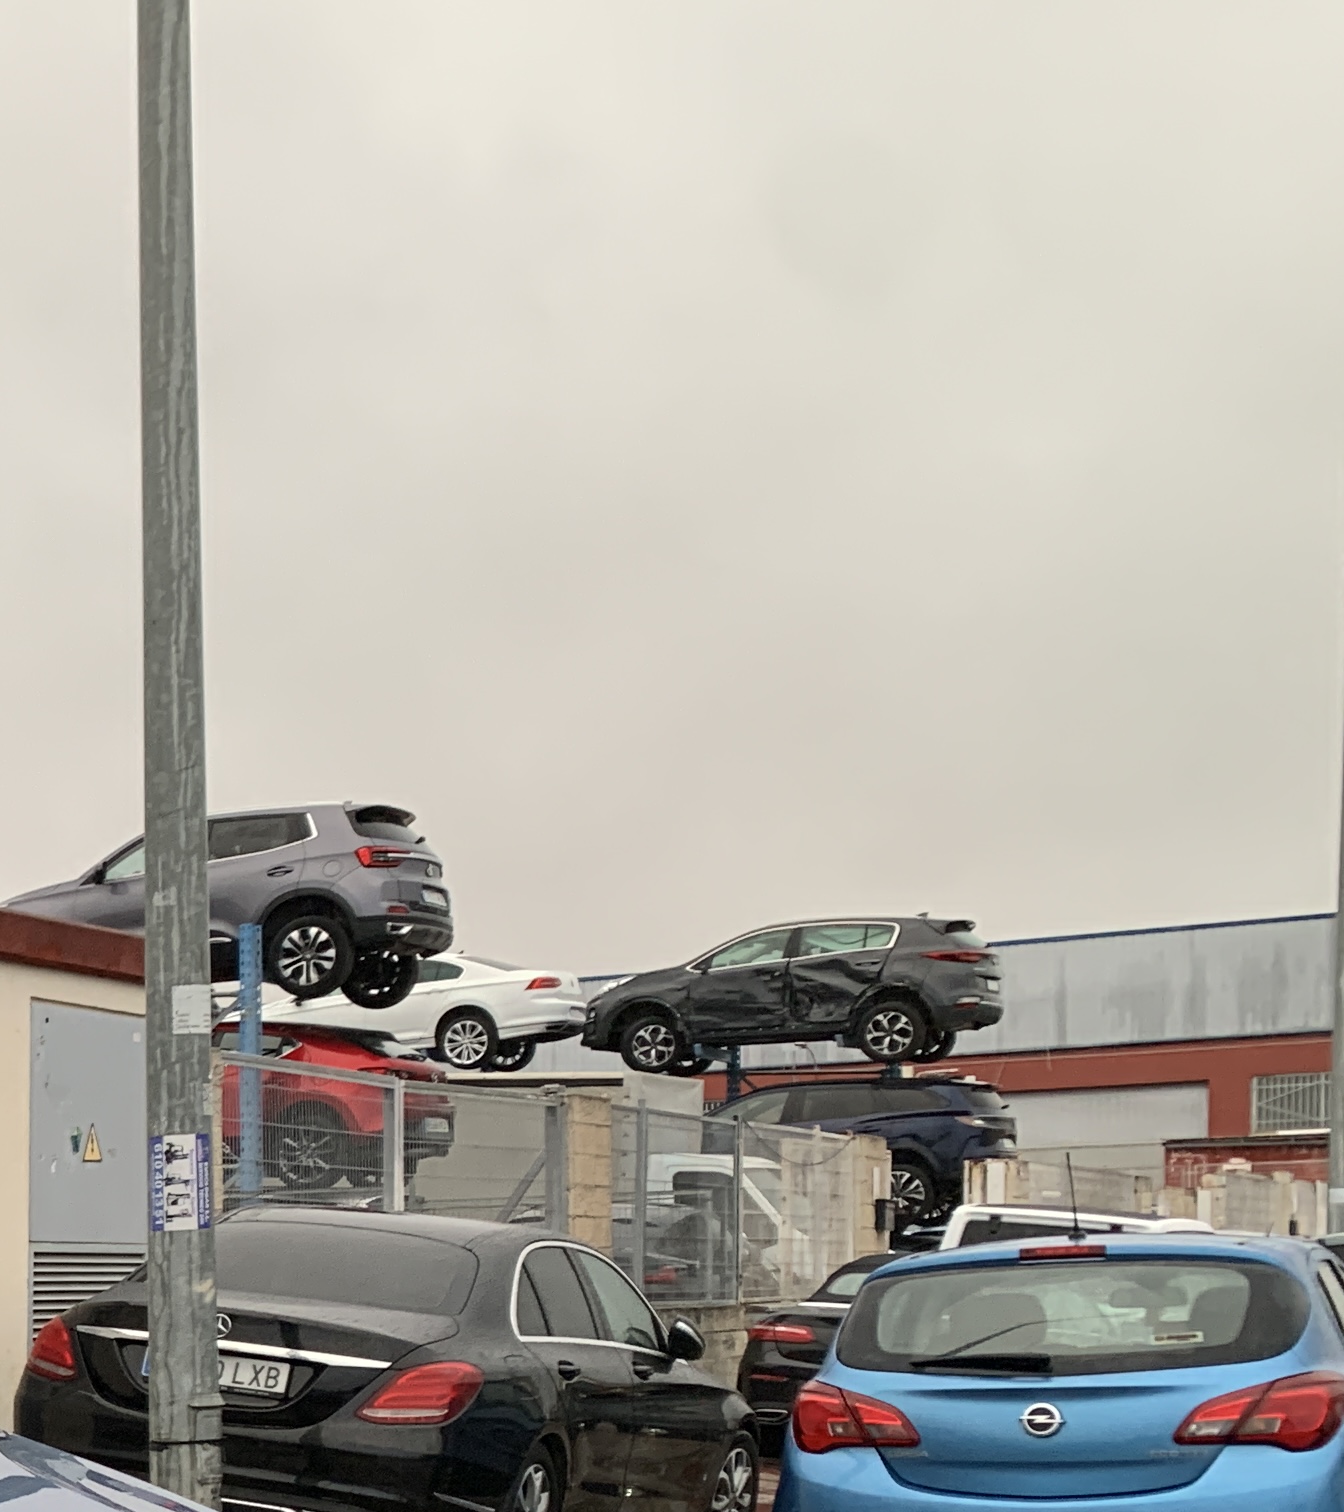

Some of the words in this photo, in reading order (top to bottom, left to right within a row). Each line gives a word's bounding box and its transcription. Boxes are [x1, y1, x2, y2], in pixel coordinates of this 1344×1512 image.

[154, 1143, 163, 1169] 610
[154, 1171, 163, 1189] 40
[154, 1191, 163, 1207] 13
[155, 1209, 164, 1225] 51
[232, 1362, 280, 1389] LXB
